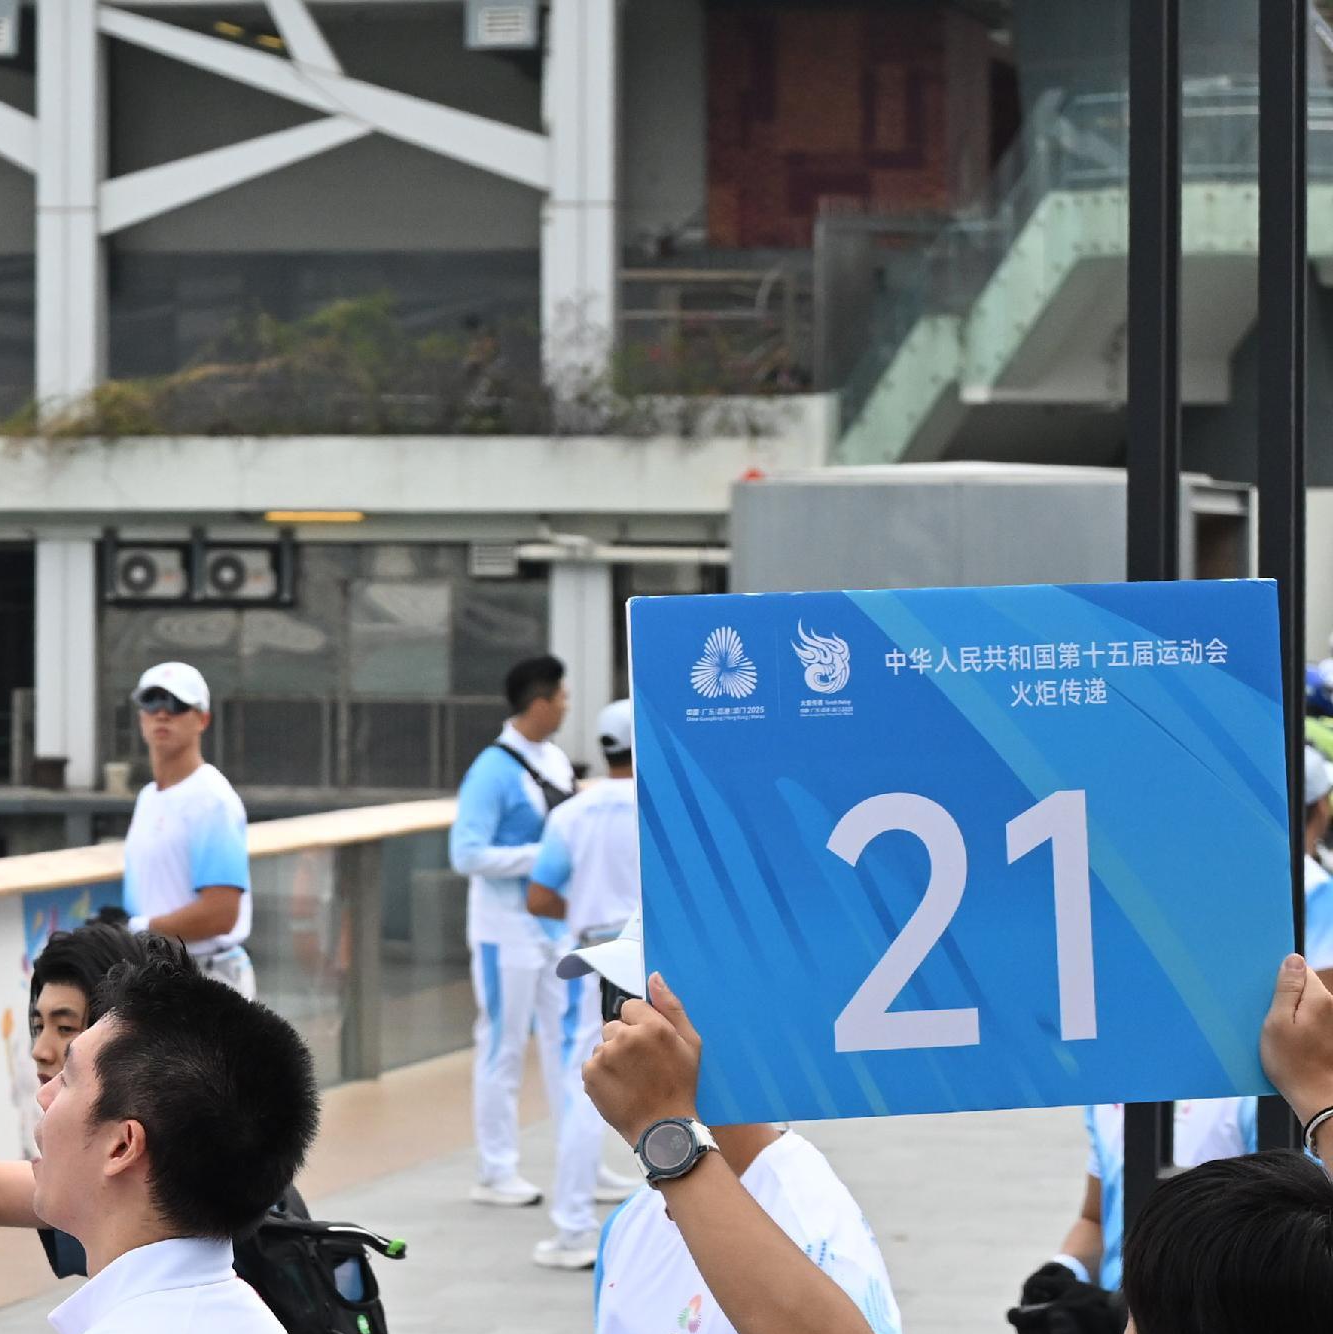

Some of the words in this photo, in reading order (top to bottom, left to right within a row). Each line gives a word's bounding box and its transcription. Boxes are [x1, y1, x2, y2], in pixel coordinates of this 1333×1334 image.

[885, 637, 1228, 676] 中华人民共和国第十五届运动会
[1010, 677, 1108, 708] 火炬传递
[826, 789, 1097, 1053] 21
